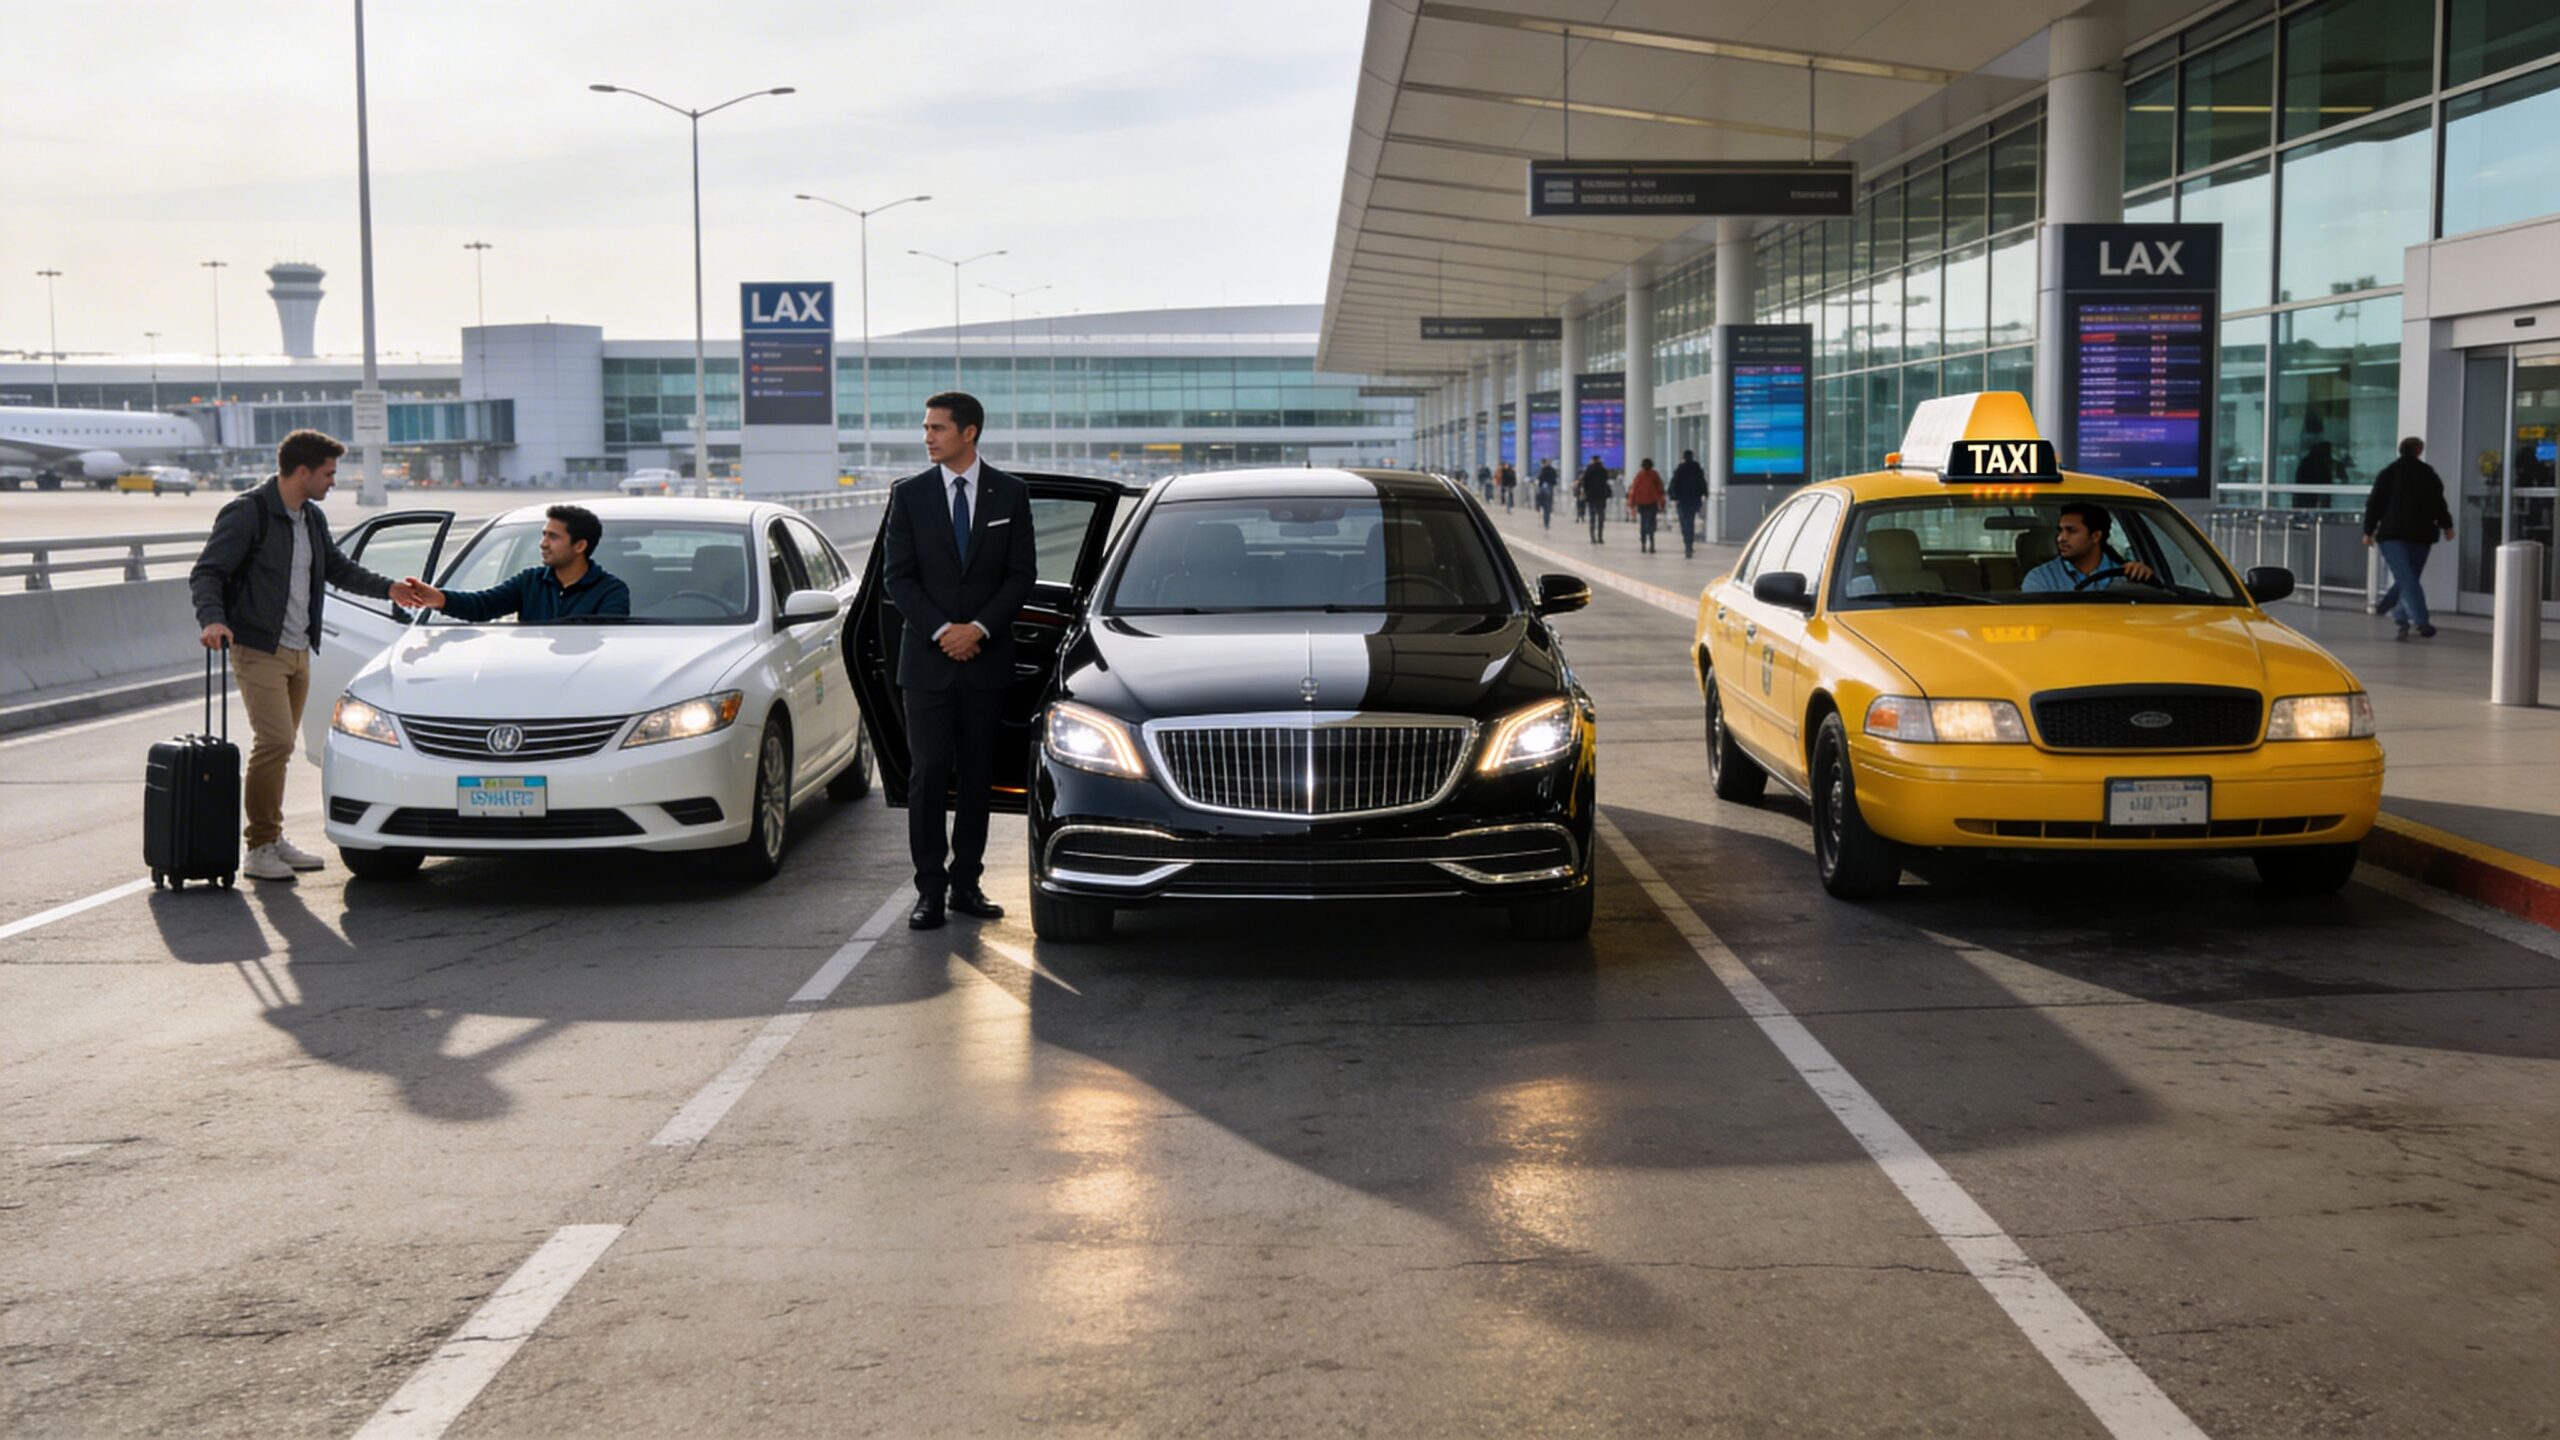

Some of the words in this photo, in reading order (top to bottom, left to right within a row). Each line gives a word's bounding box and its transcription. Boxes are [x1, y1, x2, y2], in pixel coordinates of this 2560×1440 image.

[2100, 241, 2185, 276] LAX
[752, 292, 825, 323] LAX
[1968, 444, 2038, 474] TAXI
